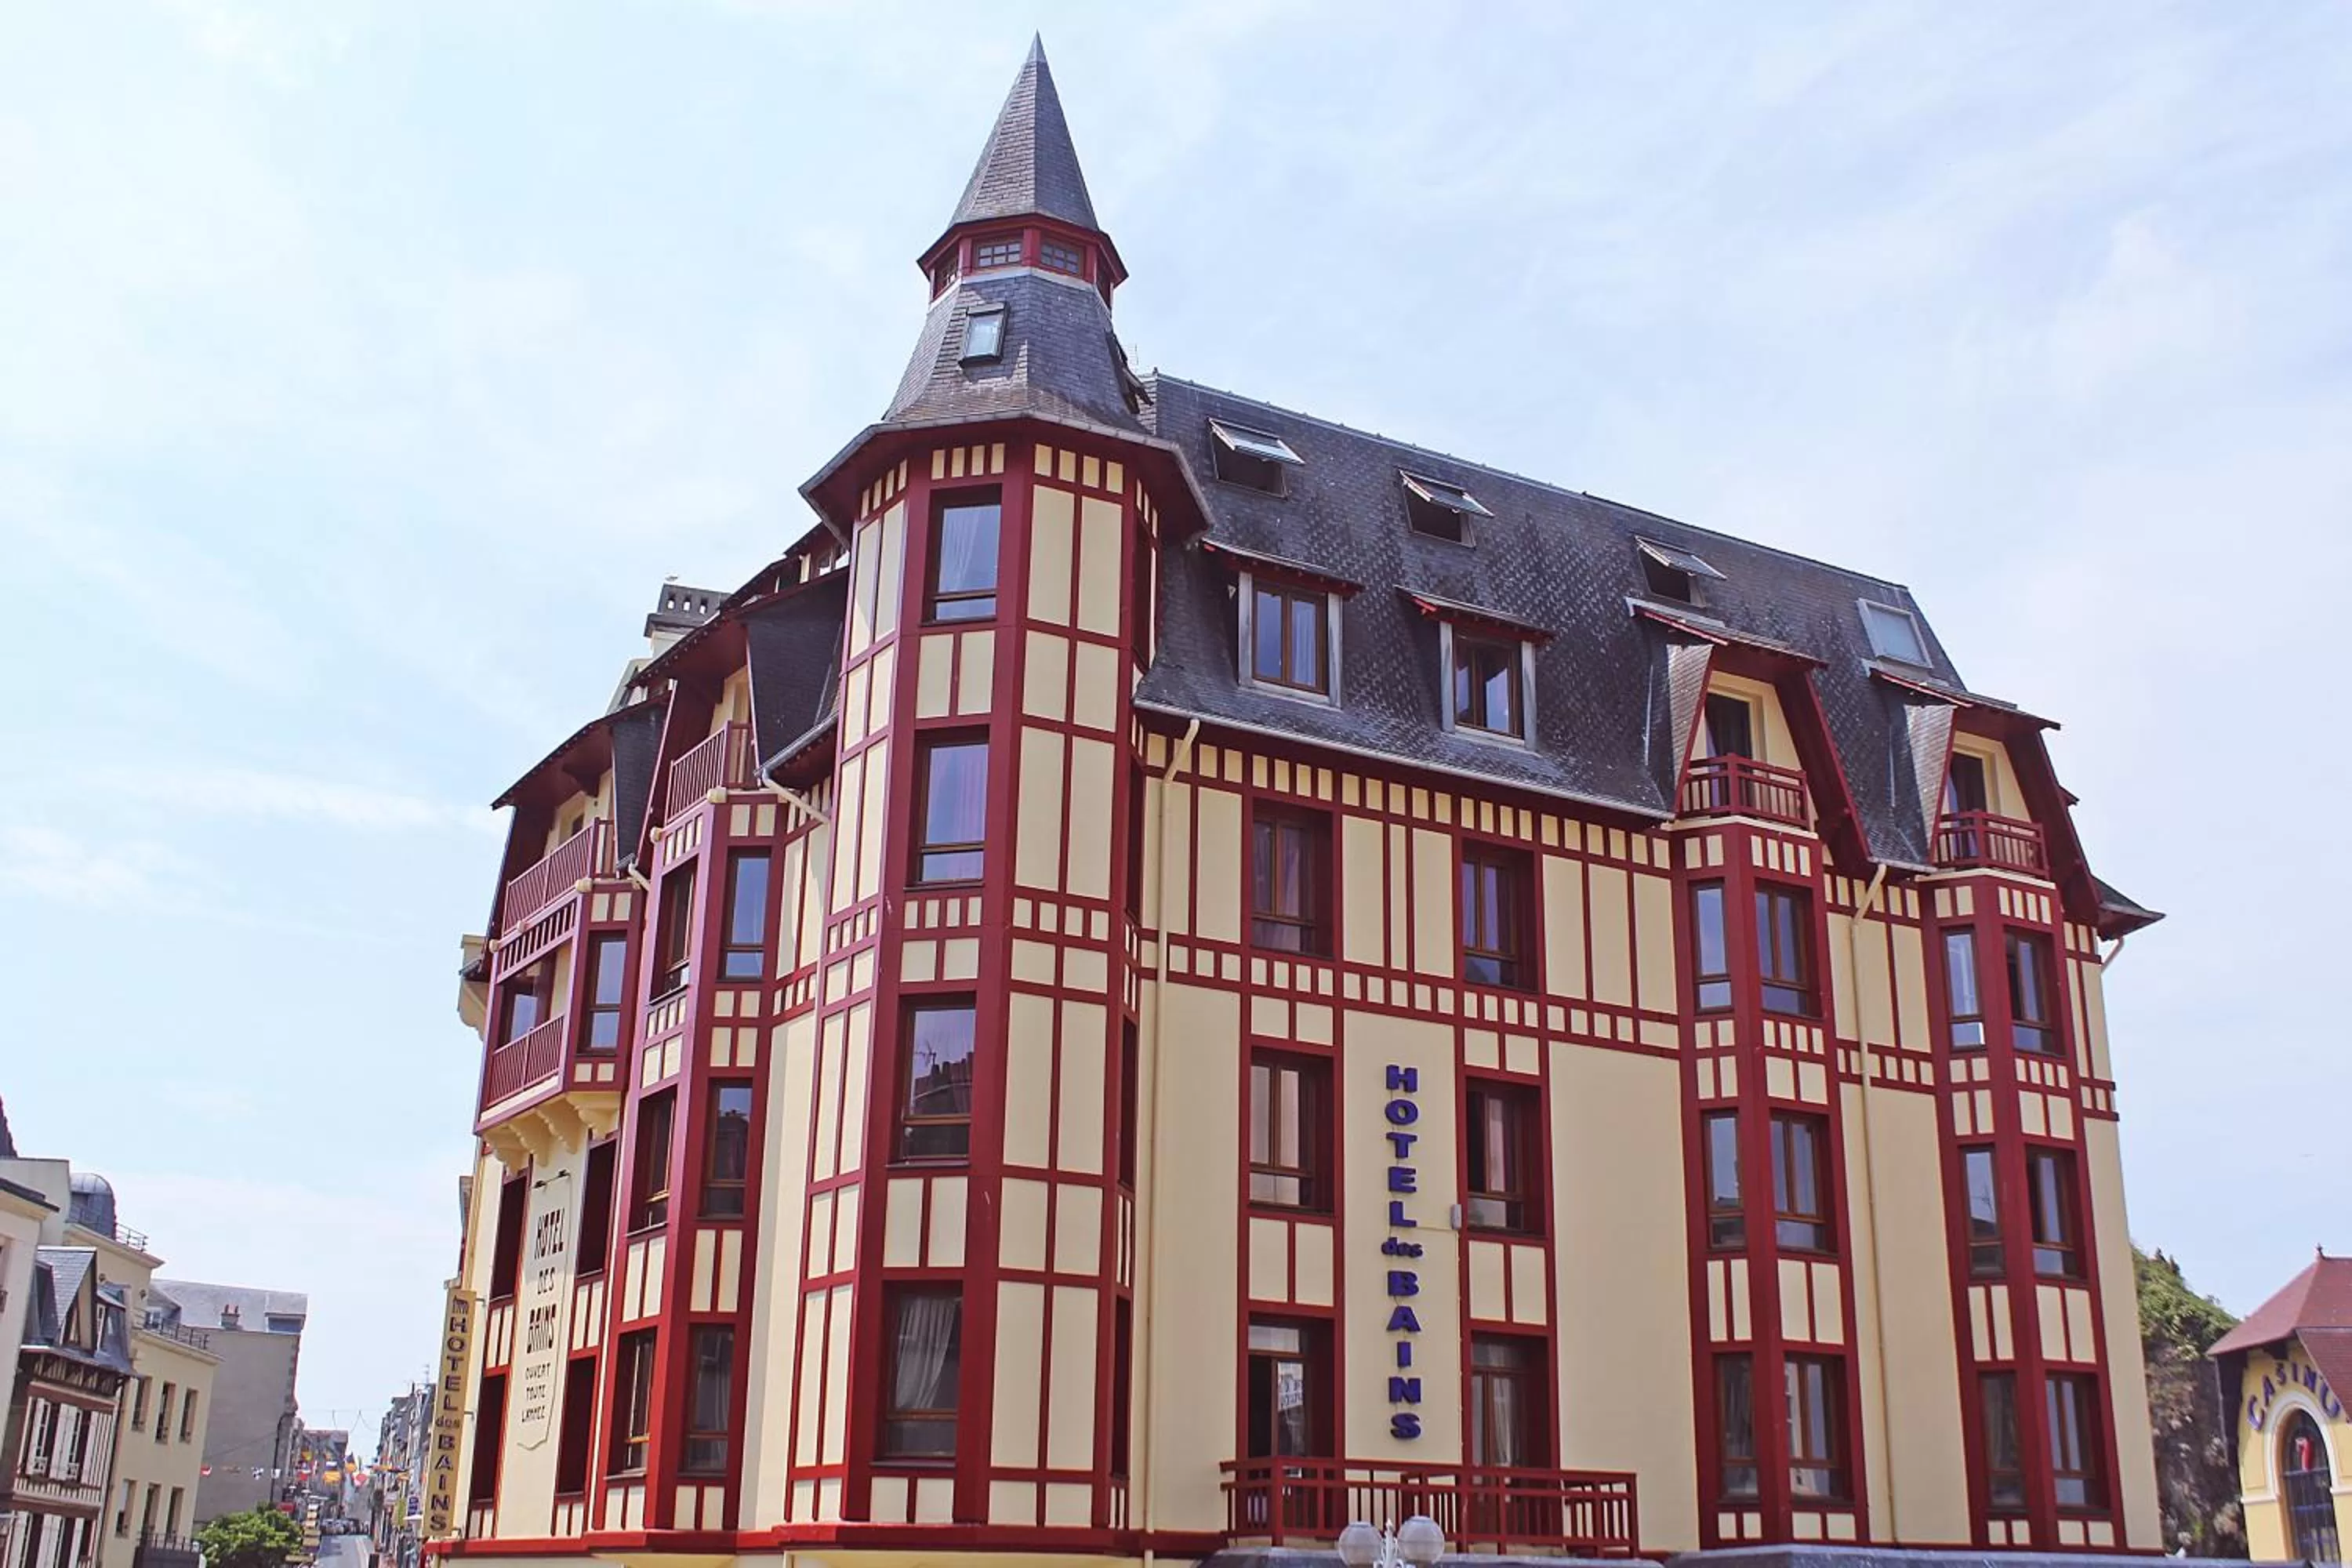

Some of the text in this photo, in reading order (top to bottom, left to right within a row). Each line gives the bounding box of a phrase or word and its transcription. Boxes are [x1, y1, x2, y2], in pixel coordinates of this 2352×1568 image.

[534, 1207, 565, 1260] HOTEL
[1381, 1064, 1424, 1439] HOTEL des BAINS
[537, 1266, 556, 1294] DES
[526, 1303, 557, 1354] BAINS
[430, 1316, 468, 1531] HOTEL des BAINS
[2246, 1361, 2340, 1432] CASINO
